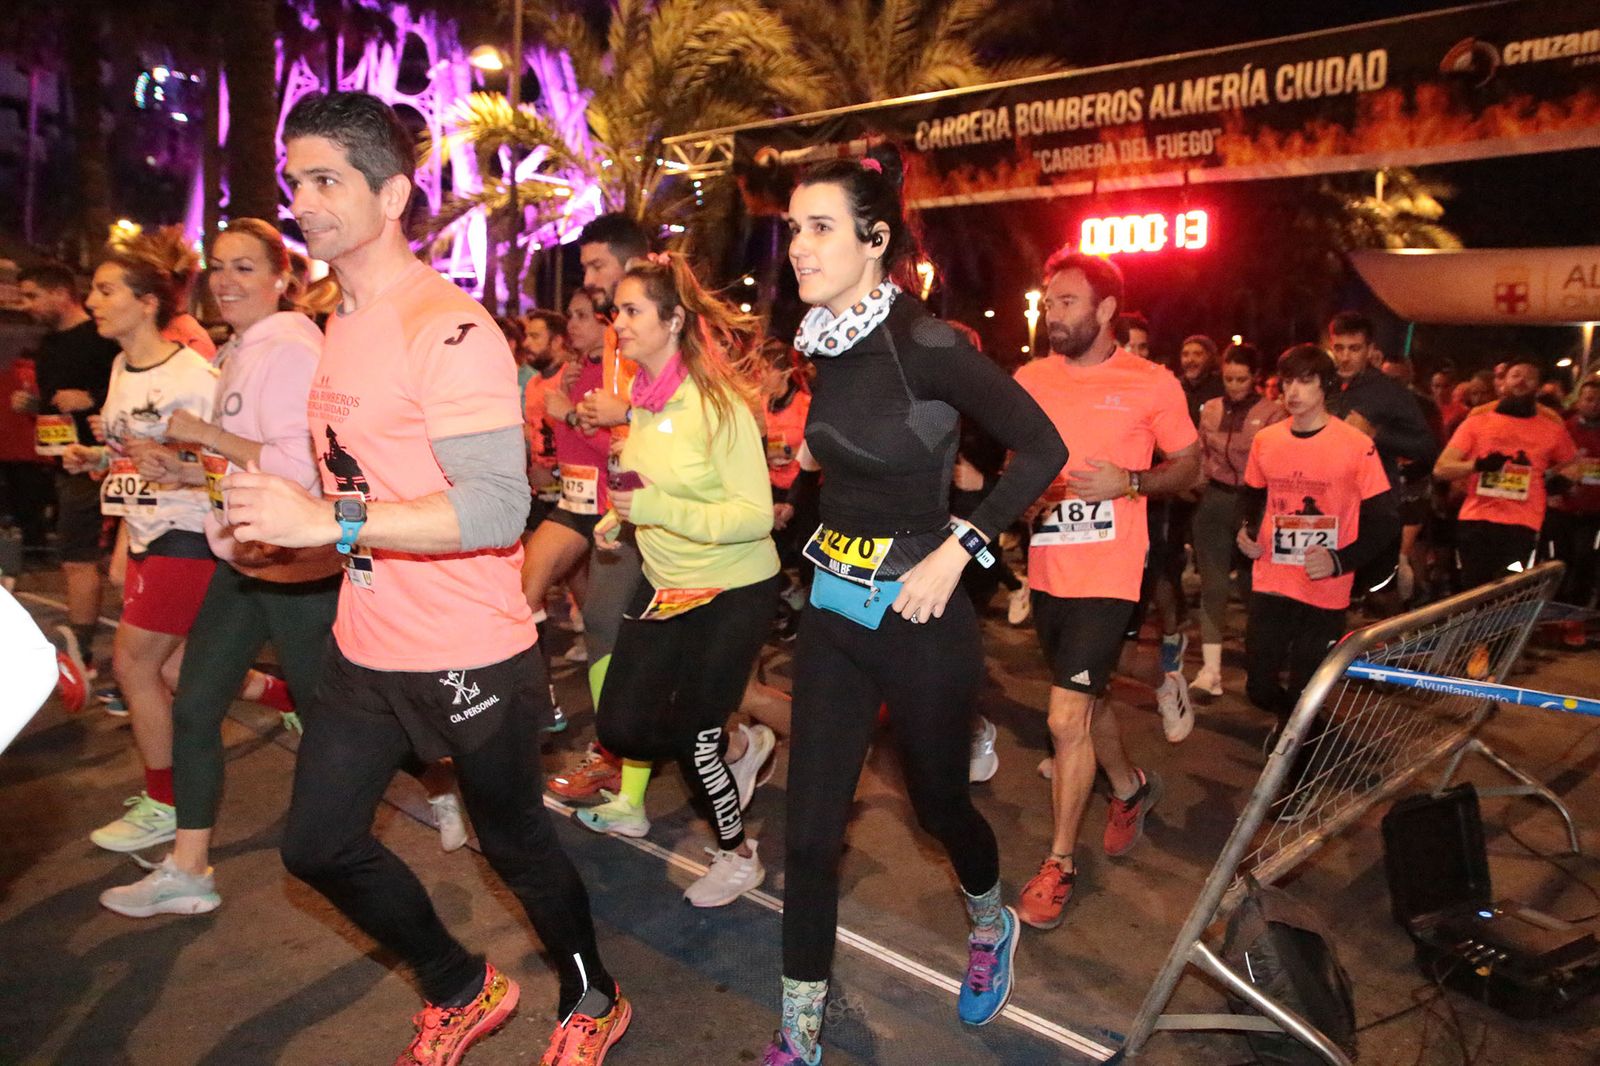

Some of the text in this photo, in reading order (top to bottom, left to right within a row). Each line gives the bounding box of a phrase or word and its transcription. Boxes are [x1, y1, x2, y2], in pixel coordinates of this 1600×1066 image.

[915, 49, 1387, 151] CARRERA BOMBEROS ALMERÍA CIUDAD
[1118, 137, 1150, 165] DEL
[113, 477, 151, 496] 302
[1051, 501, 1102, 523] 187
[1287, 531, 1329, 548] 172
[463, 695, 500, 719] PERSONAL
[694, 727, 731, 796] CALVIN
